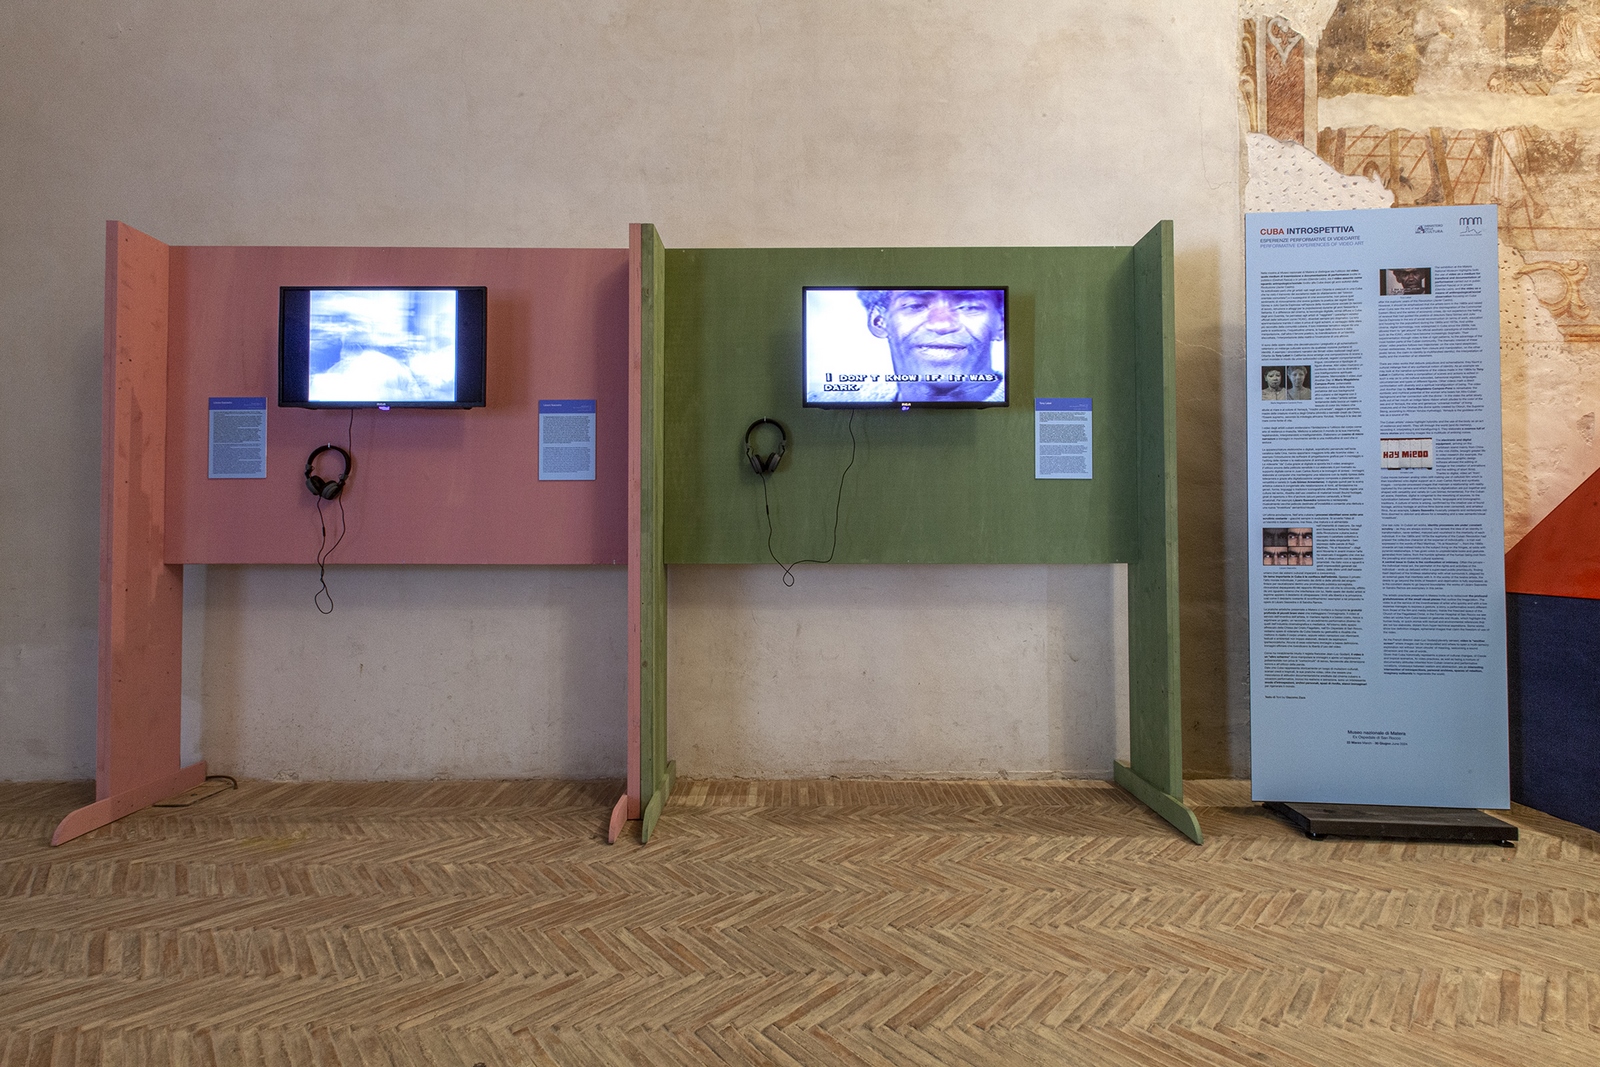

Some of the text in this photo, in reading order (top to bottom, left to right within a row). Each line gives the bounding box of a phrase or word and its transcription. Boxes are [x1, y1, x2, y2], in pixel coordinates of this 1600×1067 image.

[1286, 225, 1355, 235] INTROSPETTIVA
[826, 373, 832, 382] I
[885, 374, 919, 382] KNOW
